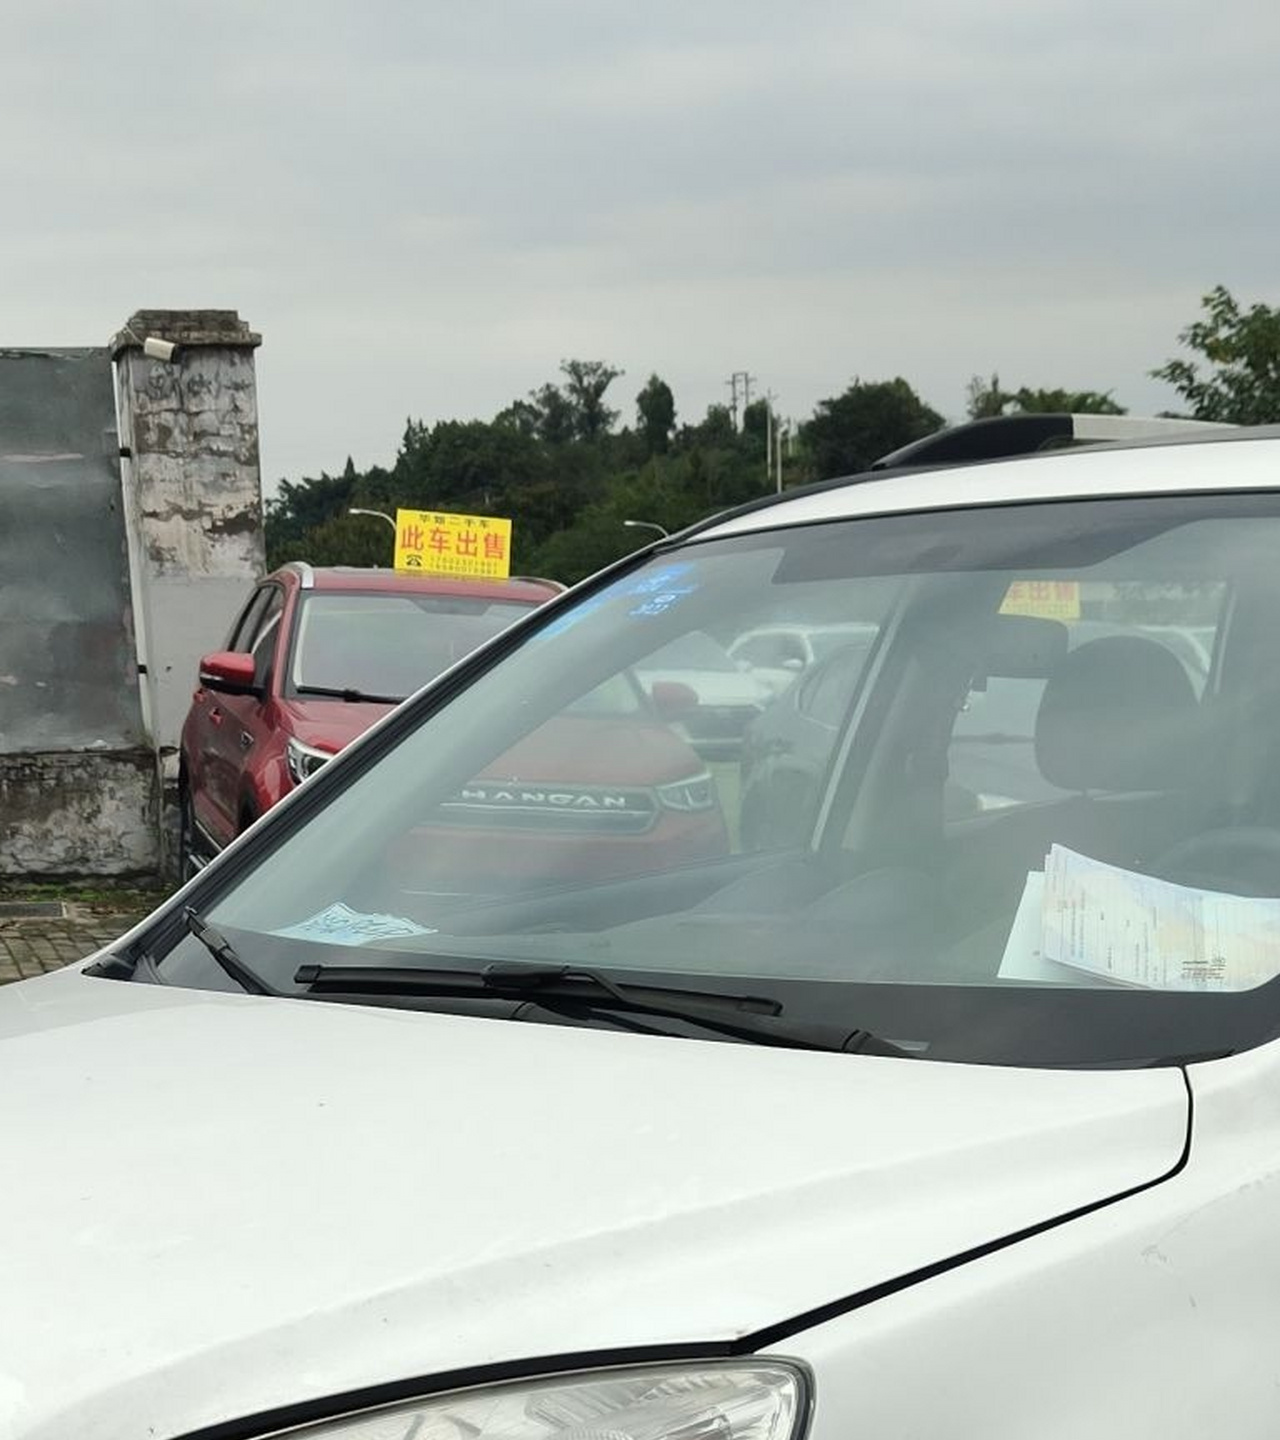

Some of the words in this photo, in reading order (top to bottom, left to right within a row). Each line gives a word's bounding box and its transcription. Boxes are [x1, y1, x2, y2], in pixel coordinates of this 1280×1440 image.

[400, 524, 505, 559] 此车出售
[461, 789, 626, 808] HANGAN
